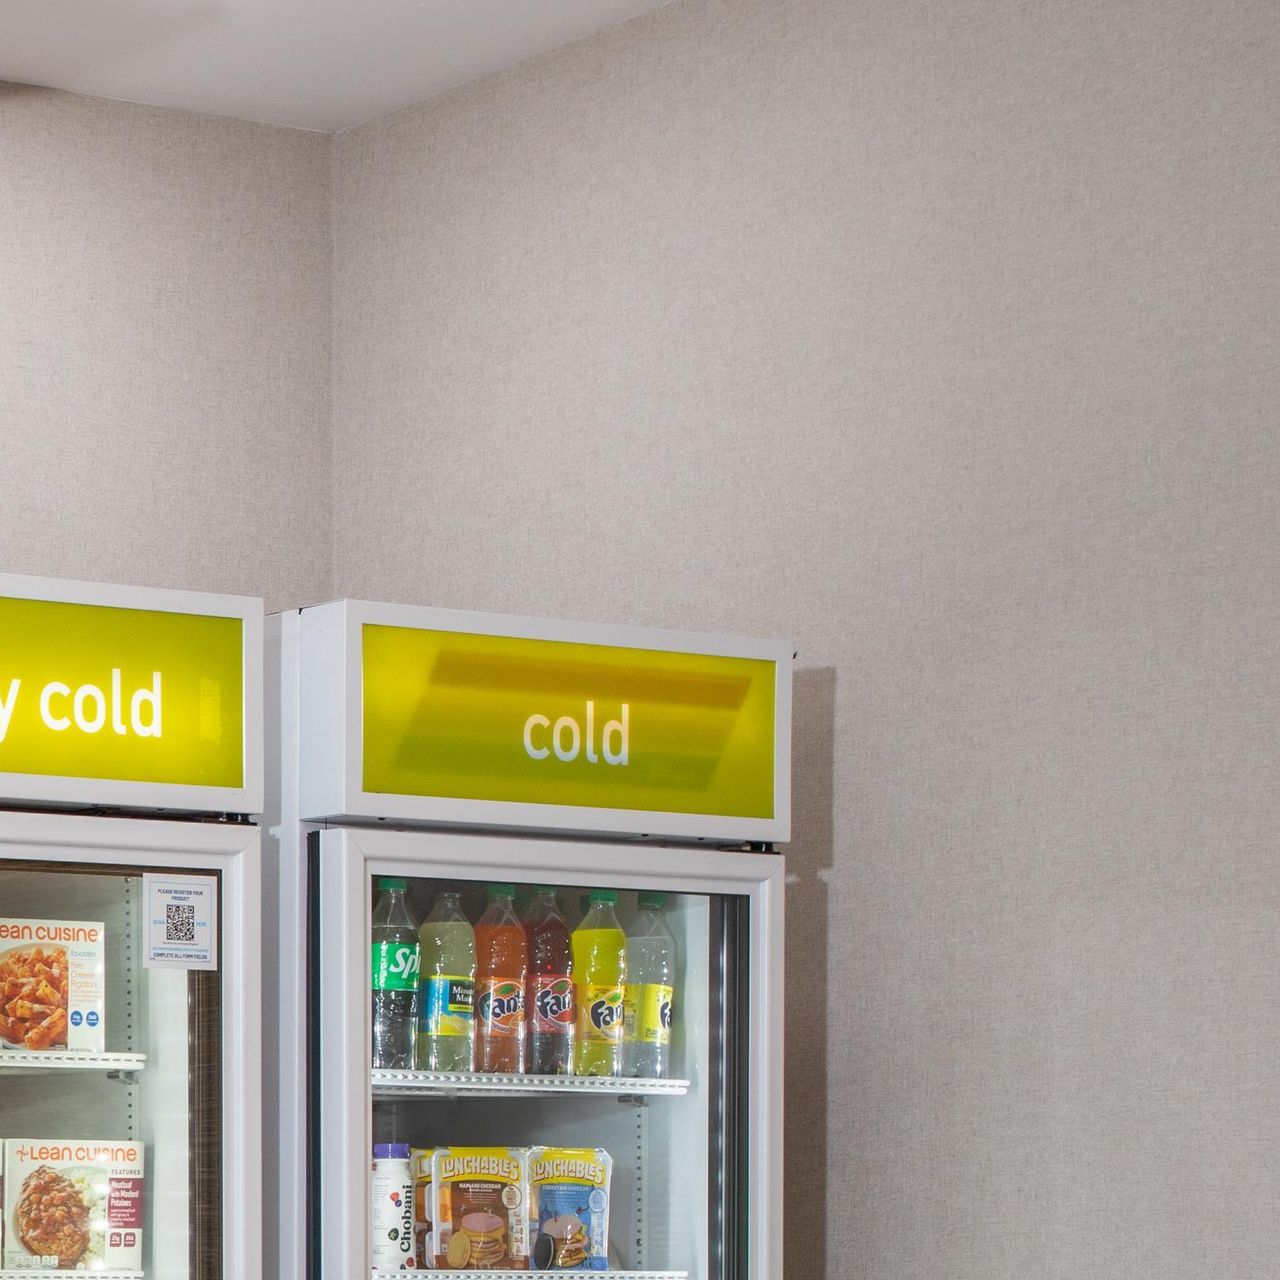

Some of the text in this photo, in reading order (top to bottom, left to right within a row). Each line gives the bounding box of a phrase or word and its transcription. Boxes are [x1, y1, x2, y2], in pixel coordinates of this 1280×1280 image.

[38, 668, 164, 739] cold
[521, 700, 630, 767] cold
[35, 926, 99, 943] cuisine
[30, 1146, 73, 1161] Lean
[441, 1155, 521, 1181] LUNCHABLES
[533, 1156, 604, 1183] LUNCHABLES
[399, 1184, 413, 1253] Chobani
